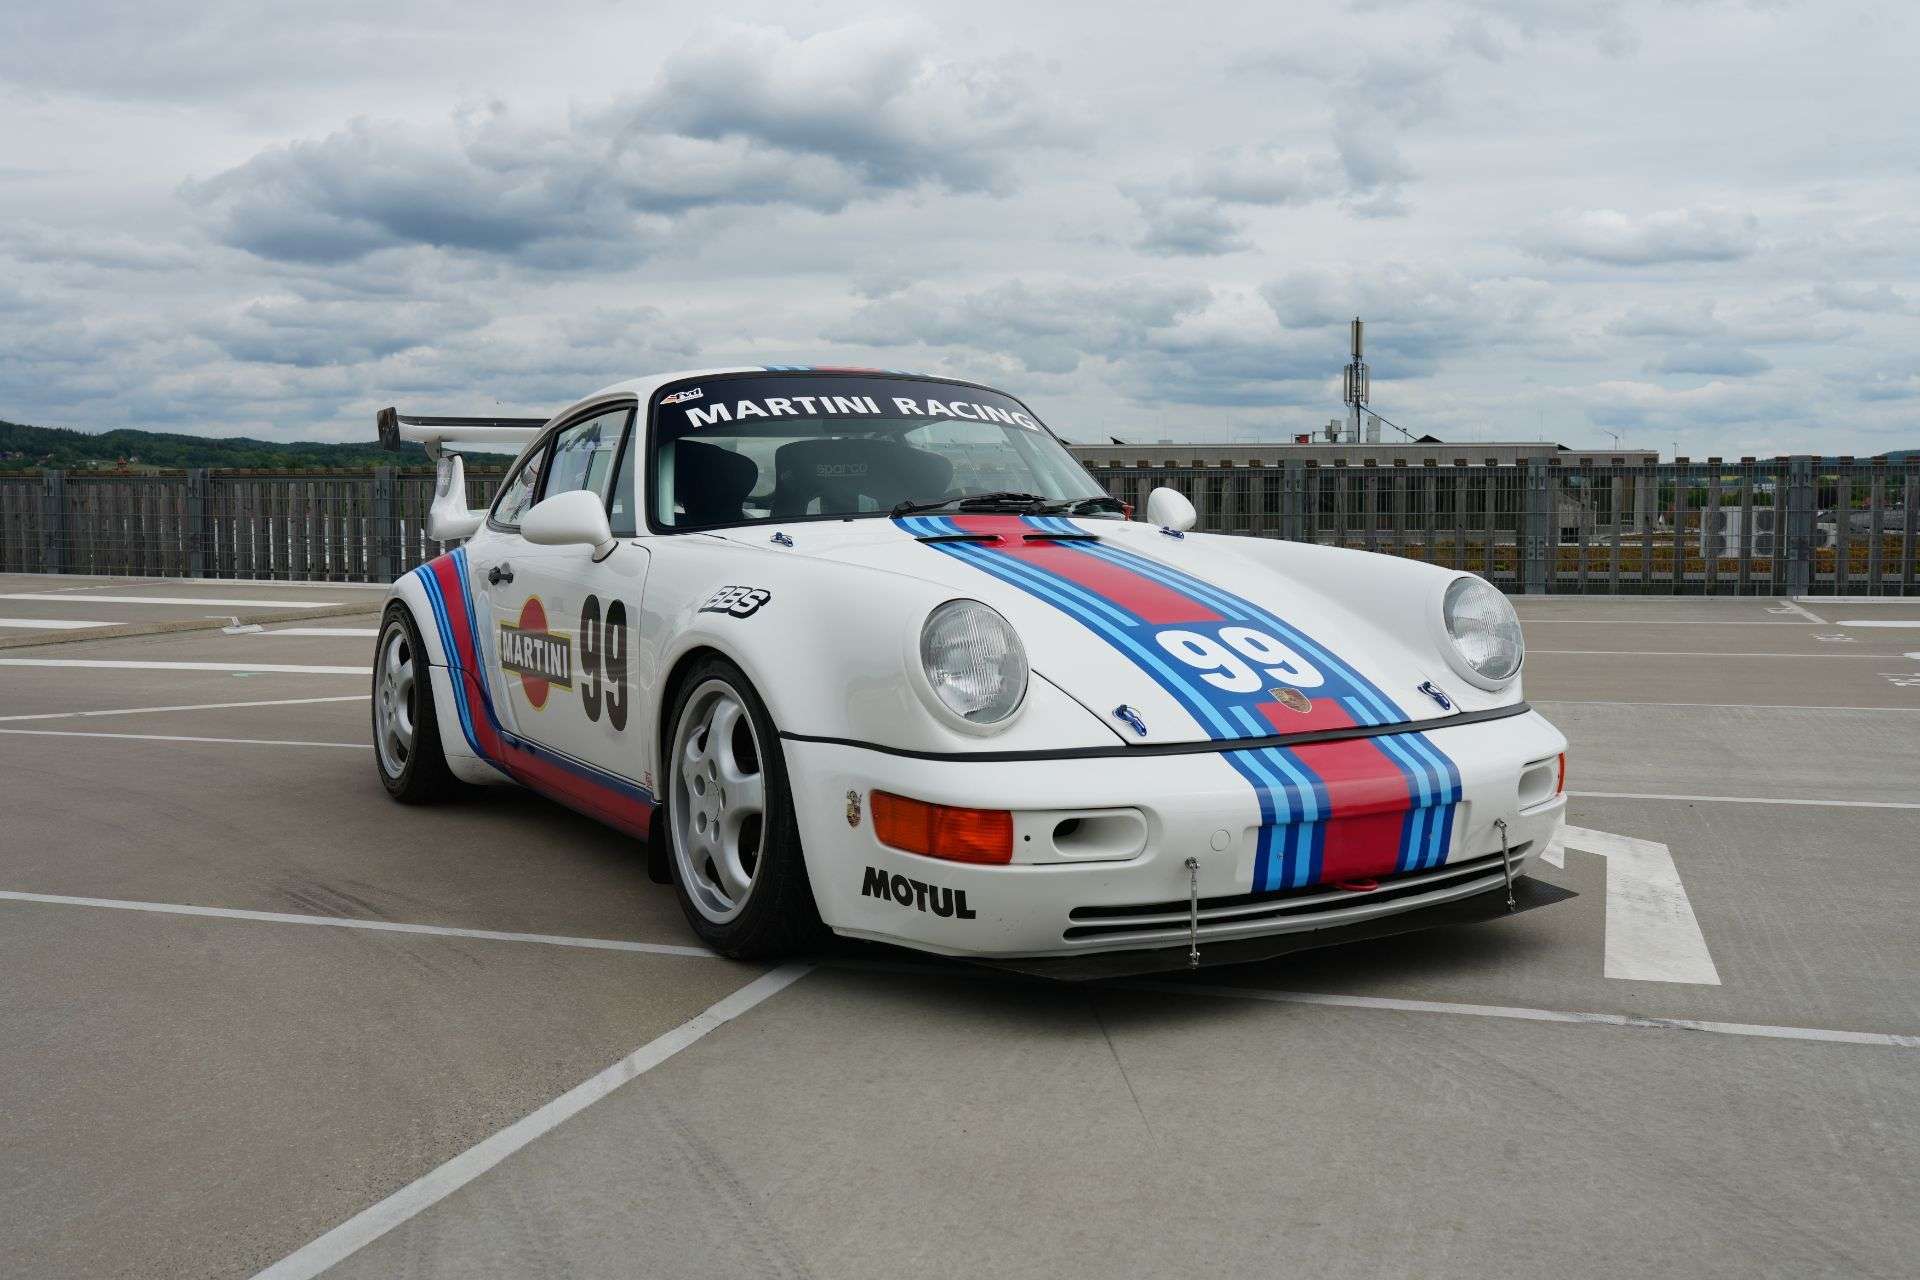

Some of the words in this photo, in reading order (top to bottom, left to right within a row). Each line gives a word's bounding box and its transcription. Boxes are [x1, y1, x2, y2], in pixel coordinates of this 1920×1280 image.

[685, 397, 882, 428] MARTINI
[892, 397, 1039, 431] RACING
[698, 586, 771, 619] BBS
[502, 630, 569, 679] MARTINI
[580, 594, 628, 731] 99
[1155, 626, 1325, 693] 99
[861, 866, 976, 919] MOTUL
